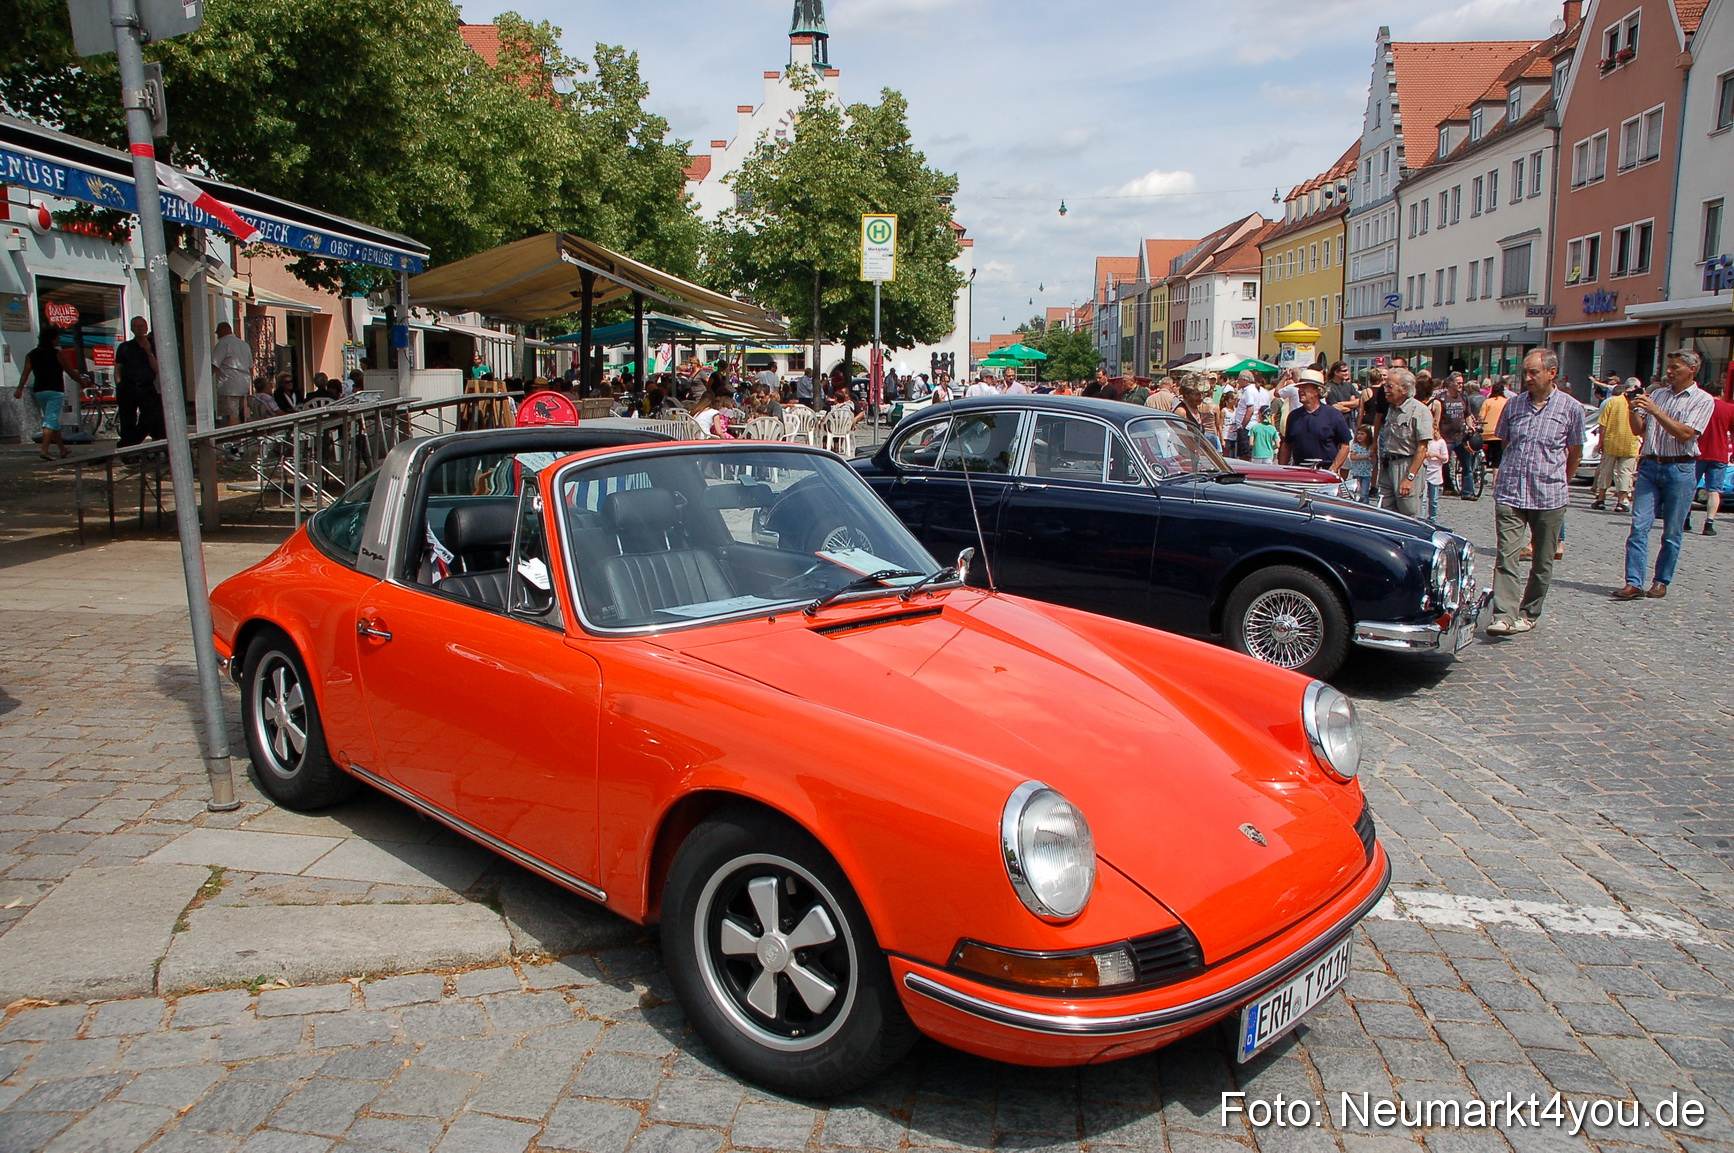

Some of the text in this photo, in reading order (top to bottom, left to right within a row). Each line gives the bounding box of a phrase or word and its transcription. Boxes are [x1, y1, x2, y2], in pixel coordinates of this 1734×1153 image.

[873, 225, 885, 239] H
[330, 240, 394, 266] OBST GEMÜSE
[1384, 294, 1400, 308] R
[1527, 307, 1555, 316] sutor
[1257, 941, 1350, 1042] ERH T 911H
[1246, 1033, 1253, 1045] D
